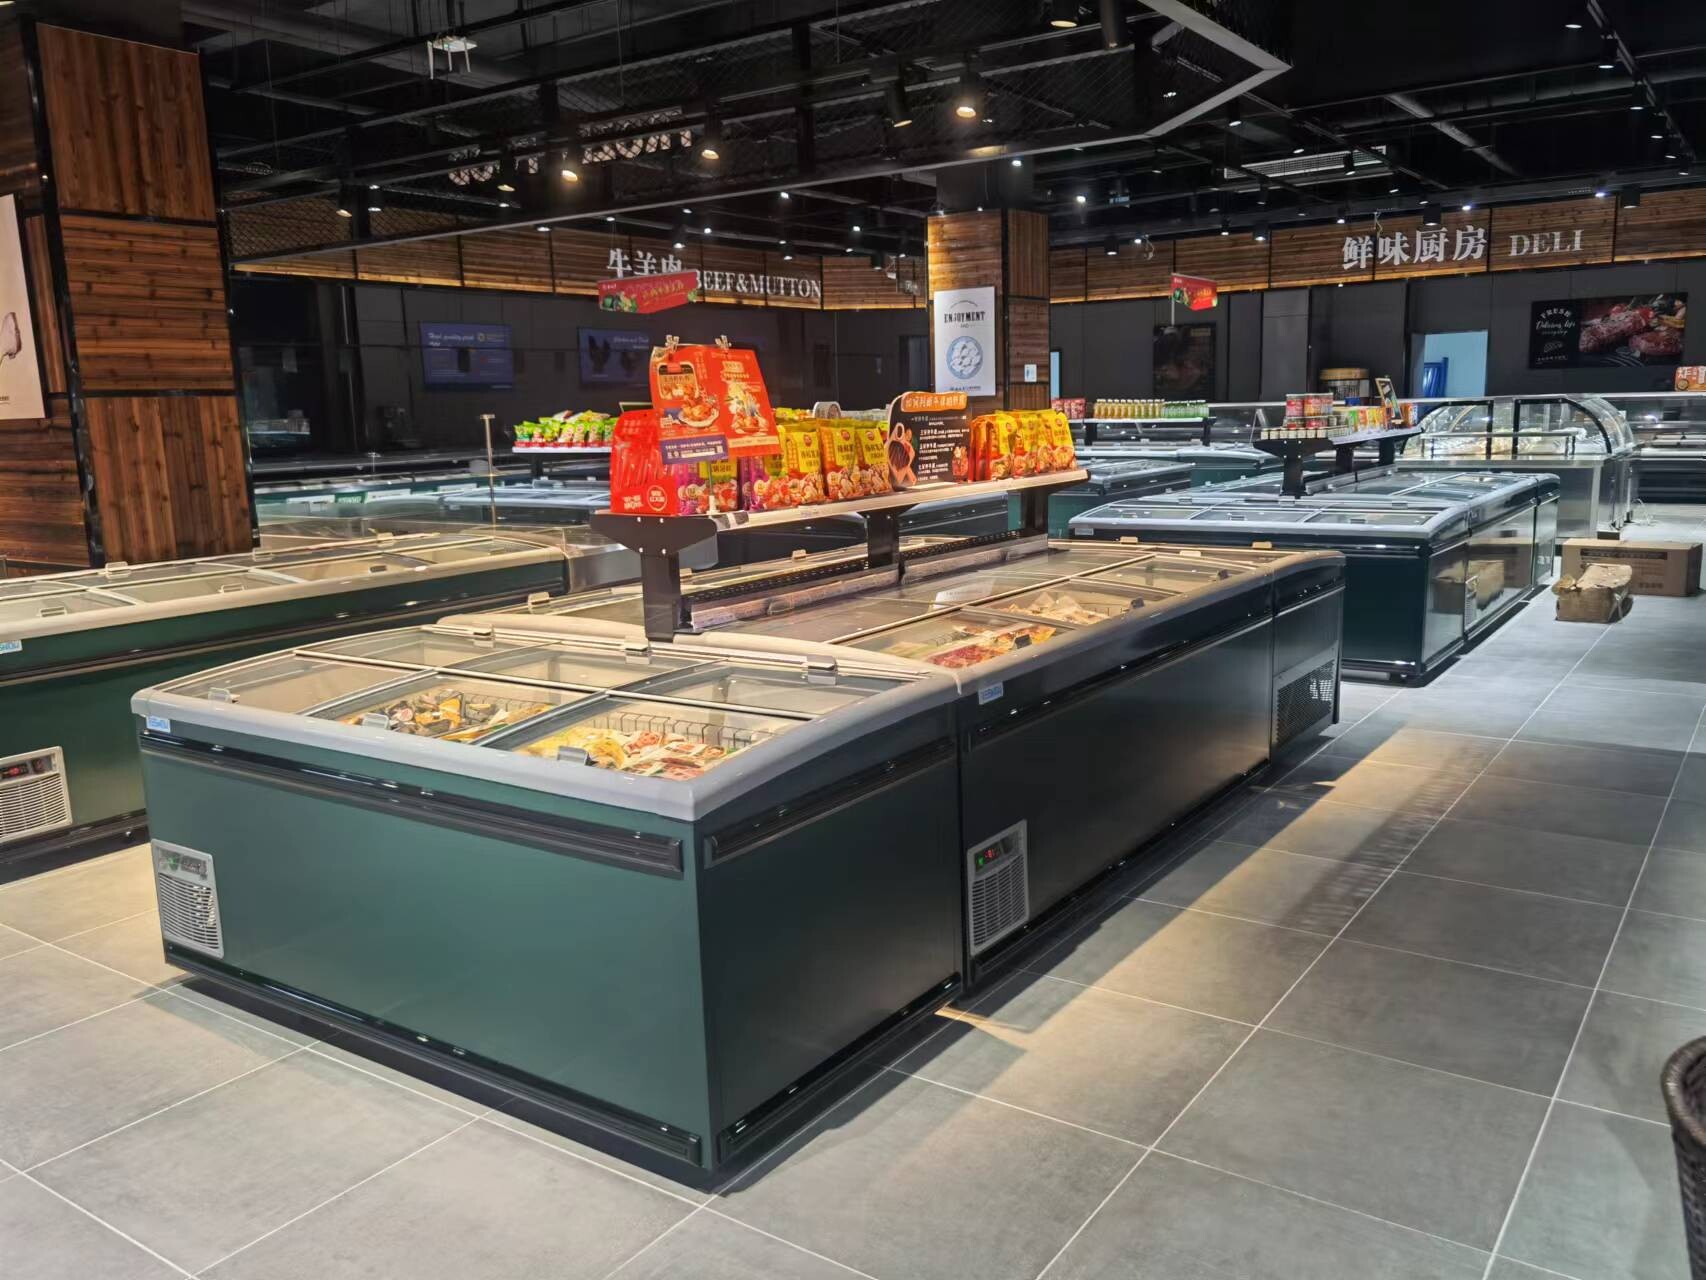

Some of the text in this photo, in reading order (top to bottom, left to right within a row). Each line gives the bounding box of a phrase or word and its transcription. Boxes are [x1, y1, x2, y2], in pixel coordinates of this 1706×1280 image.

[1342, 225, 1488, 269] 鲜味厨房
[1509, 229, 1584, 256] DELI
[944, 311, 986, 324] ENJOYMENT
[1540, 308, 1572, 319] FRESH
